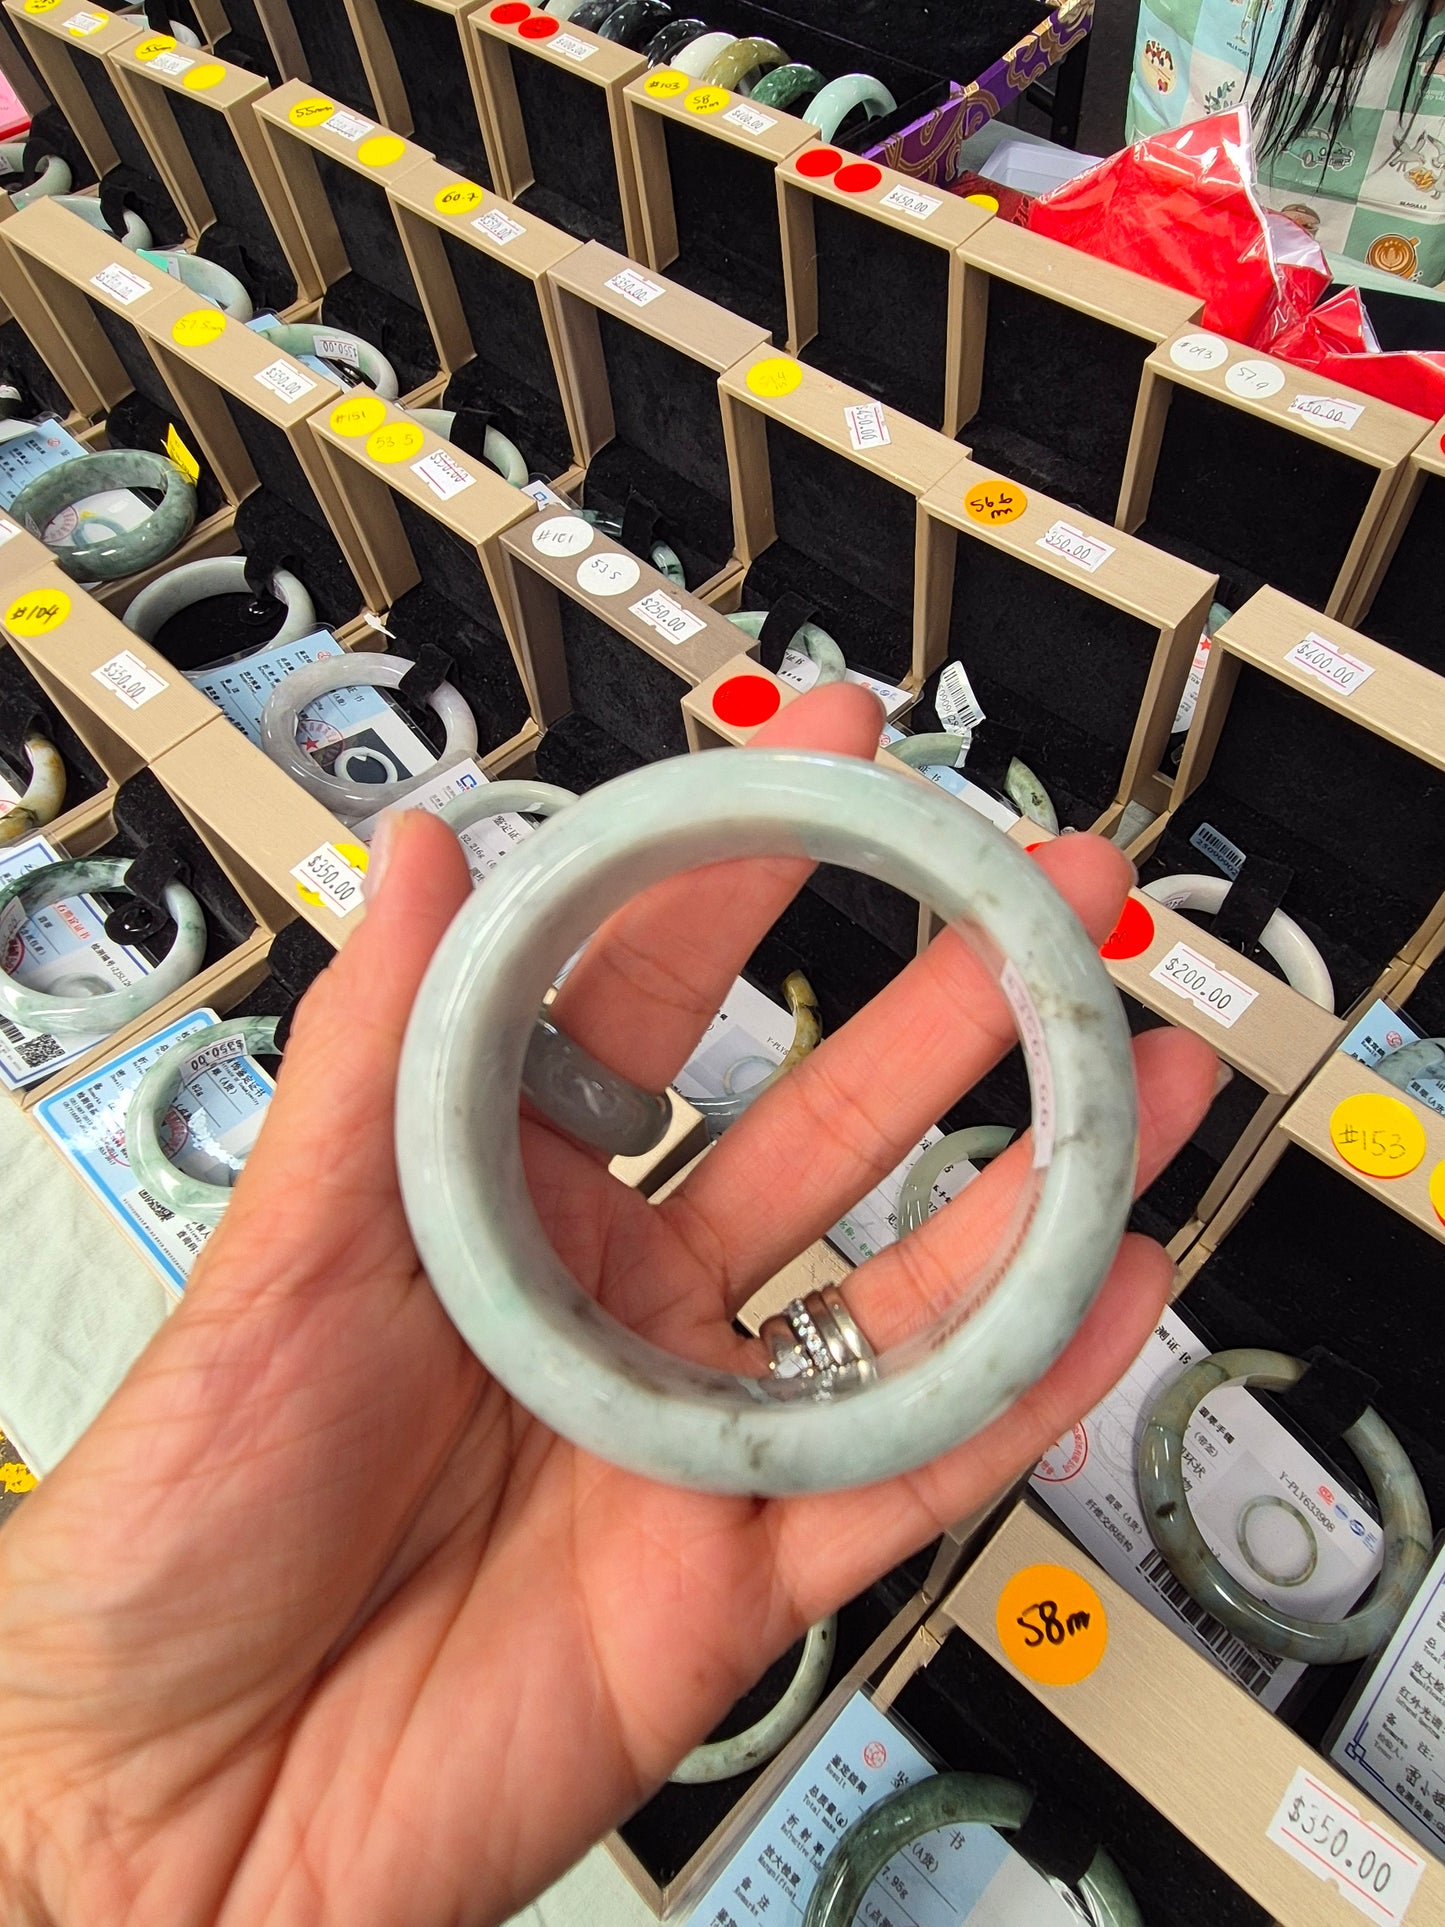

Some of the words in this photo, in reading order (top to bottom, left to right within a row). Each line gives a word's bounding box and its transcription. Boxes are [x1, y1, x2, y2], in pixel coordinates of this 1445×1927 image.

[649, 81, 680, 90] #103
[890, 189, 929, 214] $450.00
[1291, 398, 1343, 422] $450.00
[641, 597, 686, 633] $250.00
[97, 660, 146, 699] $350.00
[1296, 640, 1355, 685] $400.00
[306, 853, 356, 901] $350.00
[1165, 957, 1232, 1010] $200.00
[190, 1038, 244, 1072] $350.00
[1337, 1123, 1408, 1161] #153
[1279, 1470, 1336, 1533] Y-PLY633908
[829, 1753, 868, 1797] 鉴定结果
[802, 1793, 820, 1817] Total
[1287, 1795, 1393, 1894] $350.00
[763, 1843, 802, 1888] 放大检查
[733, 1886, 760, 1917] Remarks
